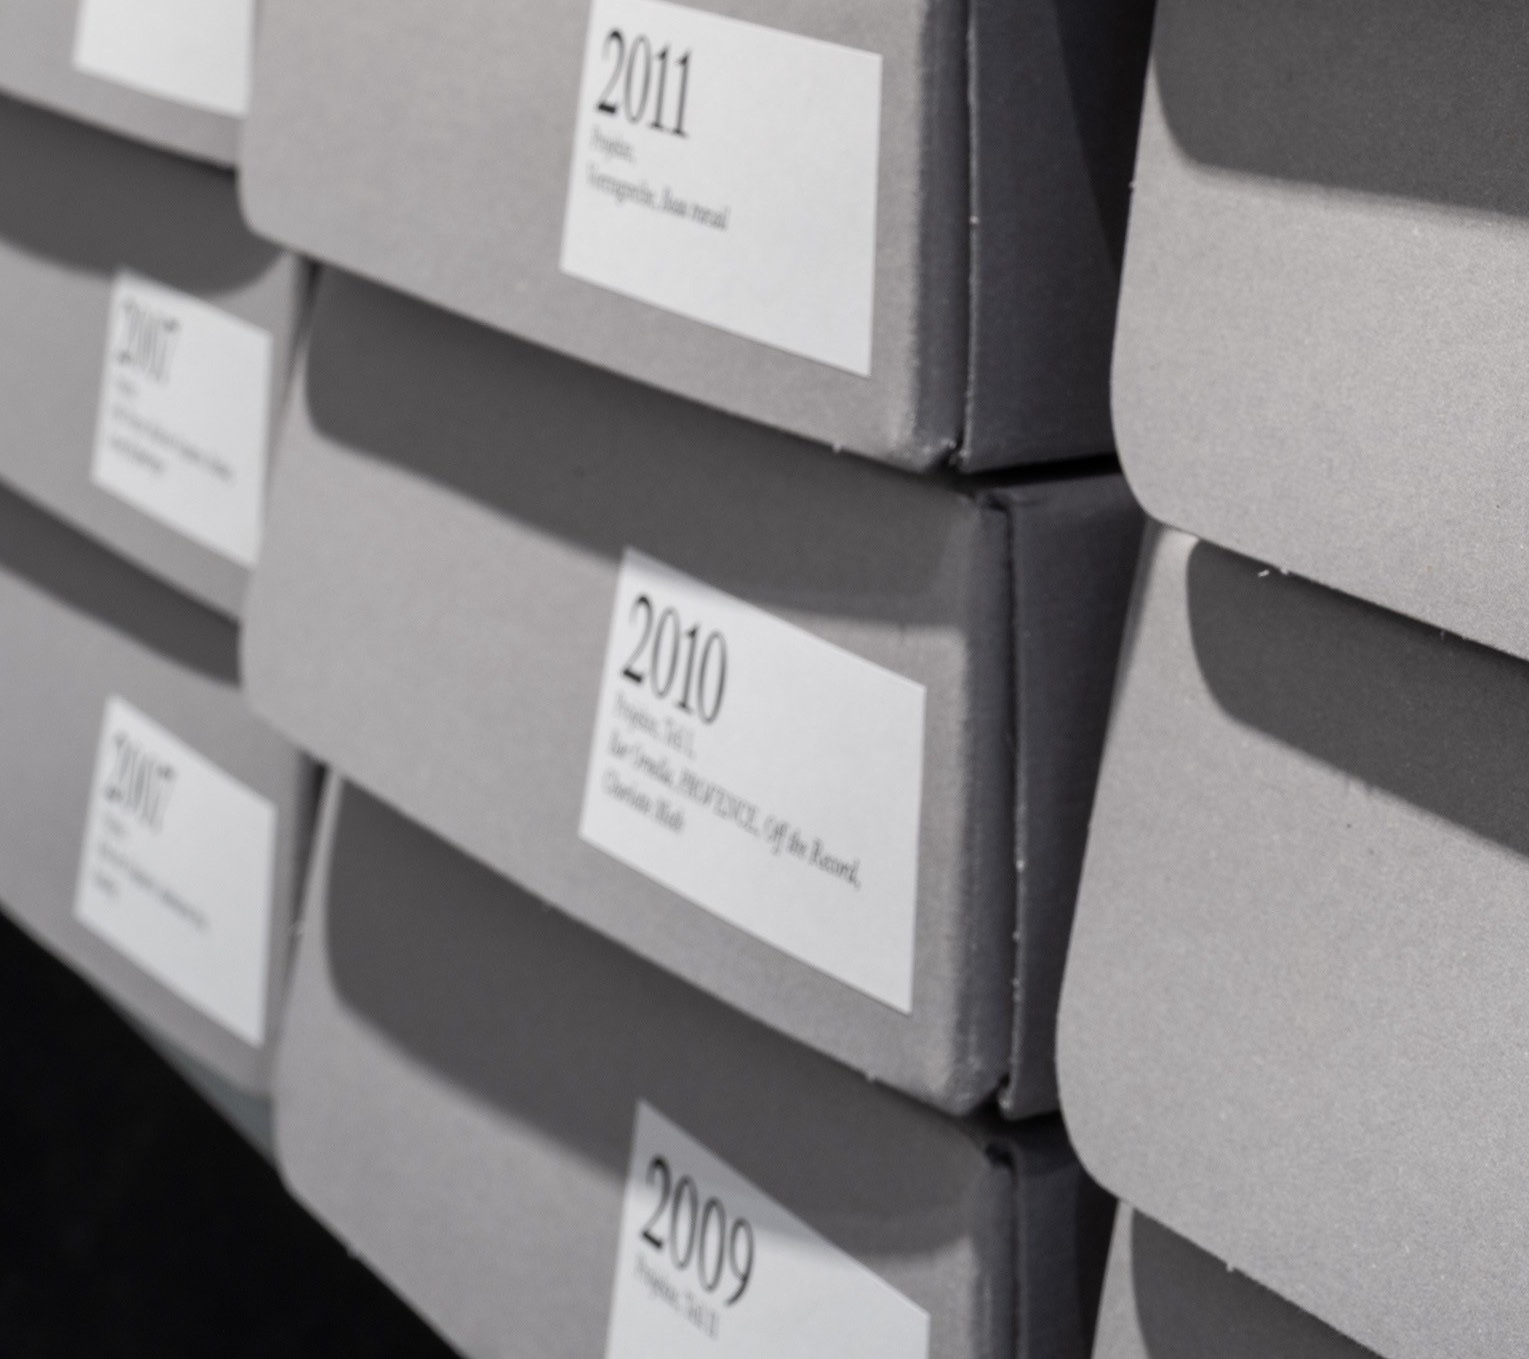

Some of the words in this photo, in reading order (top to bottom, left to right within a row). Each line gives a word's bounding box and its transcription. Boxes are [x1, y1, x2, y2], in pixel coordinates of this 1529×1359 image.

[596, 25, 692, 140] 2011
[621, 591, 728, 725] 2010
[641, 1153, 755, 1308] 2009
